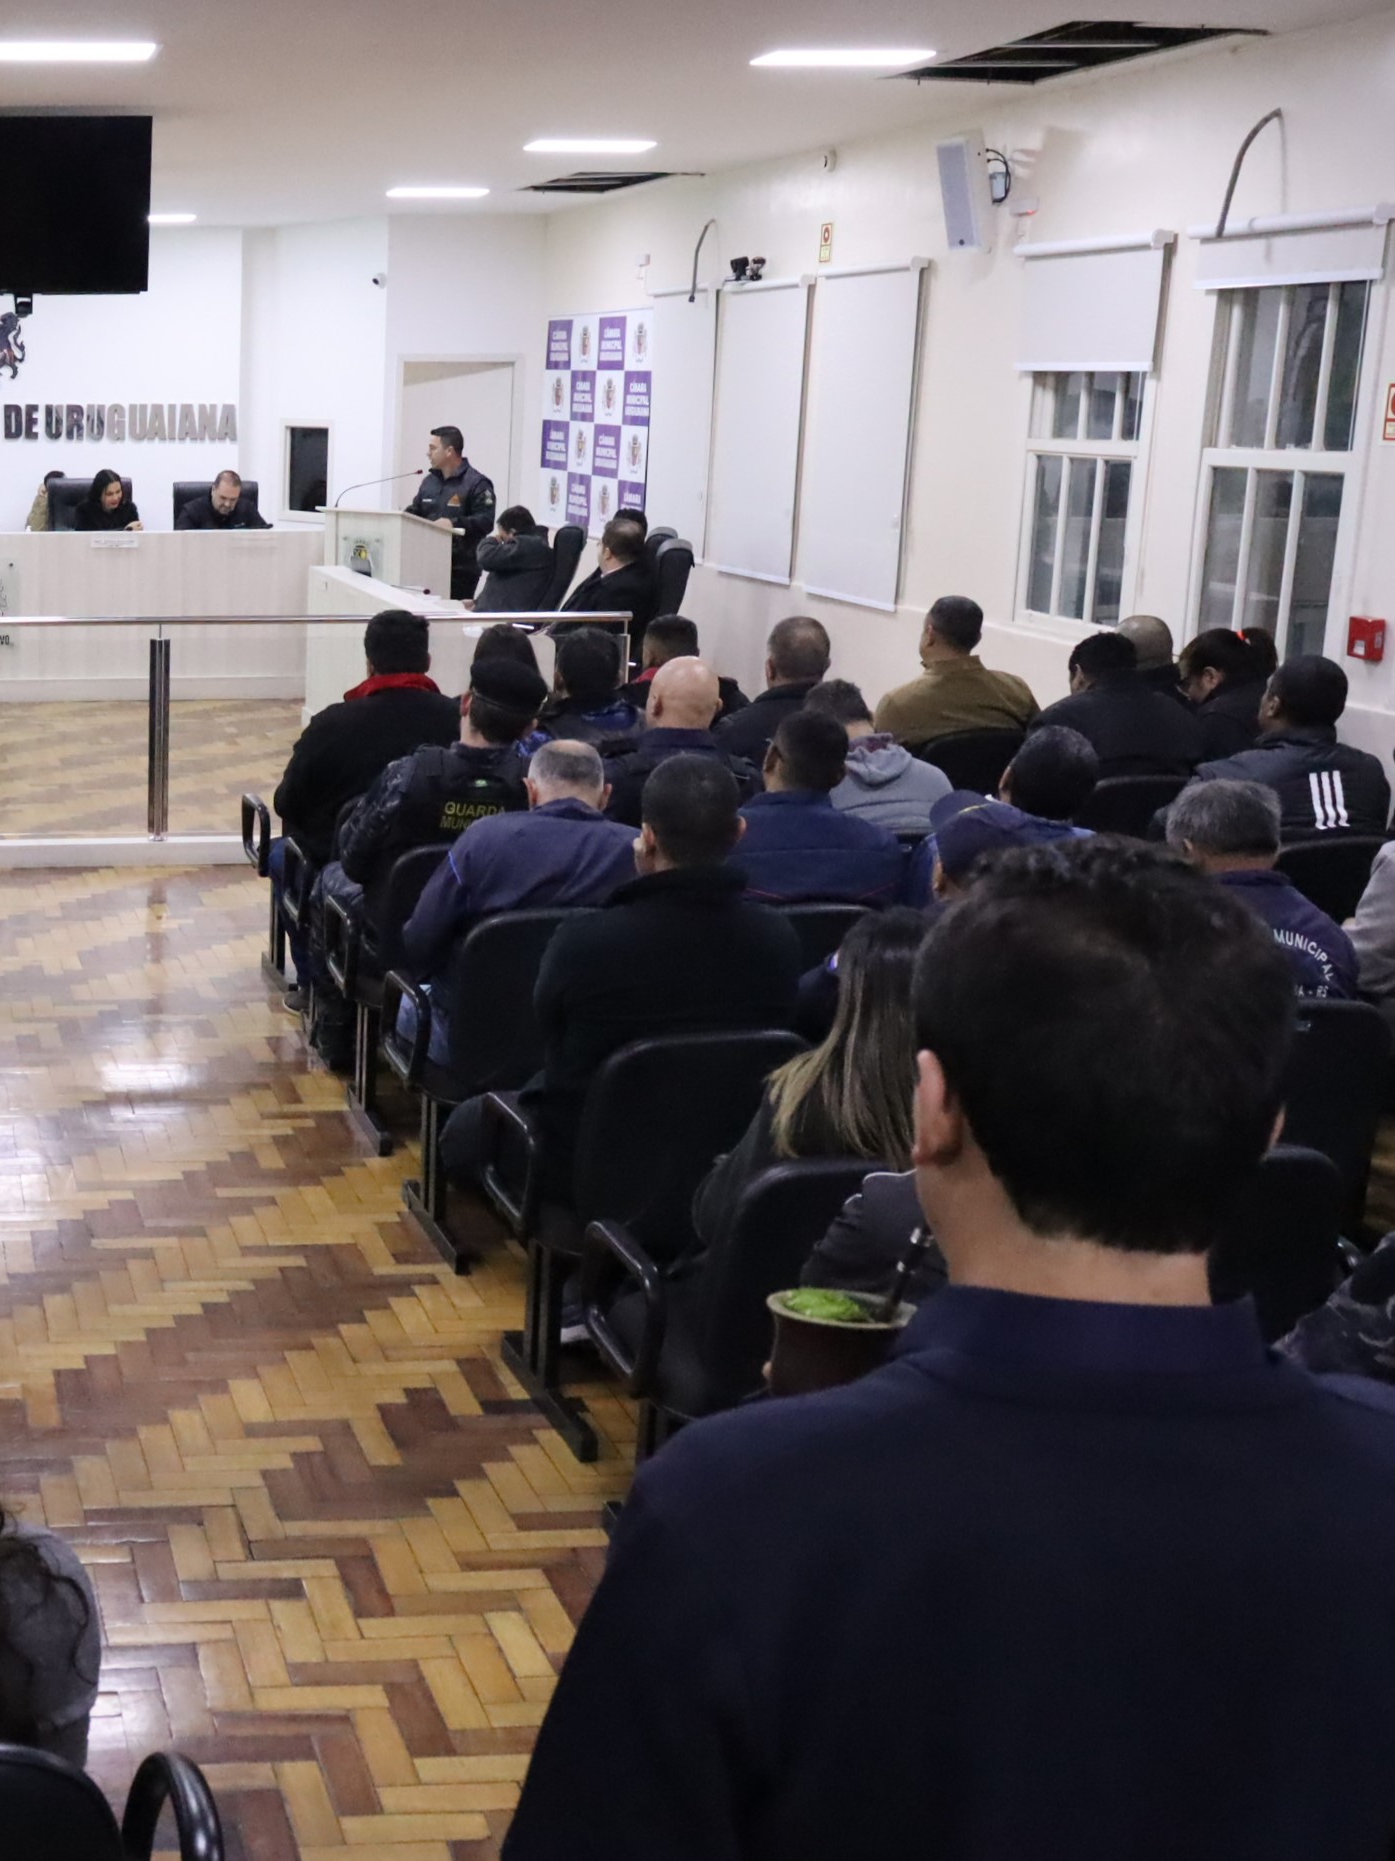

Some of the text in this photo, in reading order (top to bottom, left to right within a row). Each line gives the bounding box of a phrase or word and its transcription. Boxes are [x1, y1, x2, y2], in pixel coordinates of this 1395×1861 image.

[3, 403, 39, 440] DE
[45, 403, 237, 441] URUGUAIANA
[444, 801, 506, 816] GUARDA
[1273, 928, 1334, 981] MUNICIPAL
